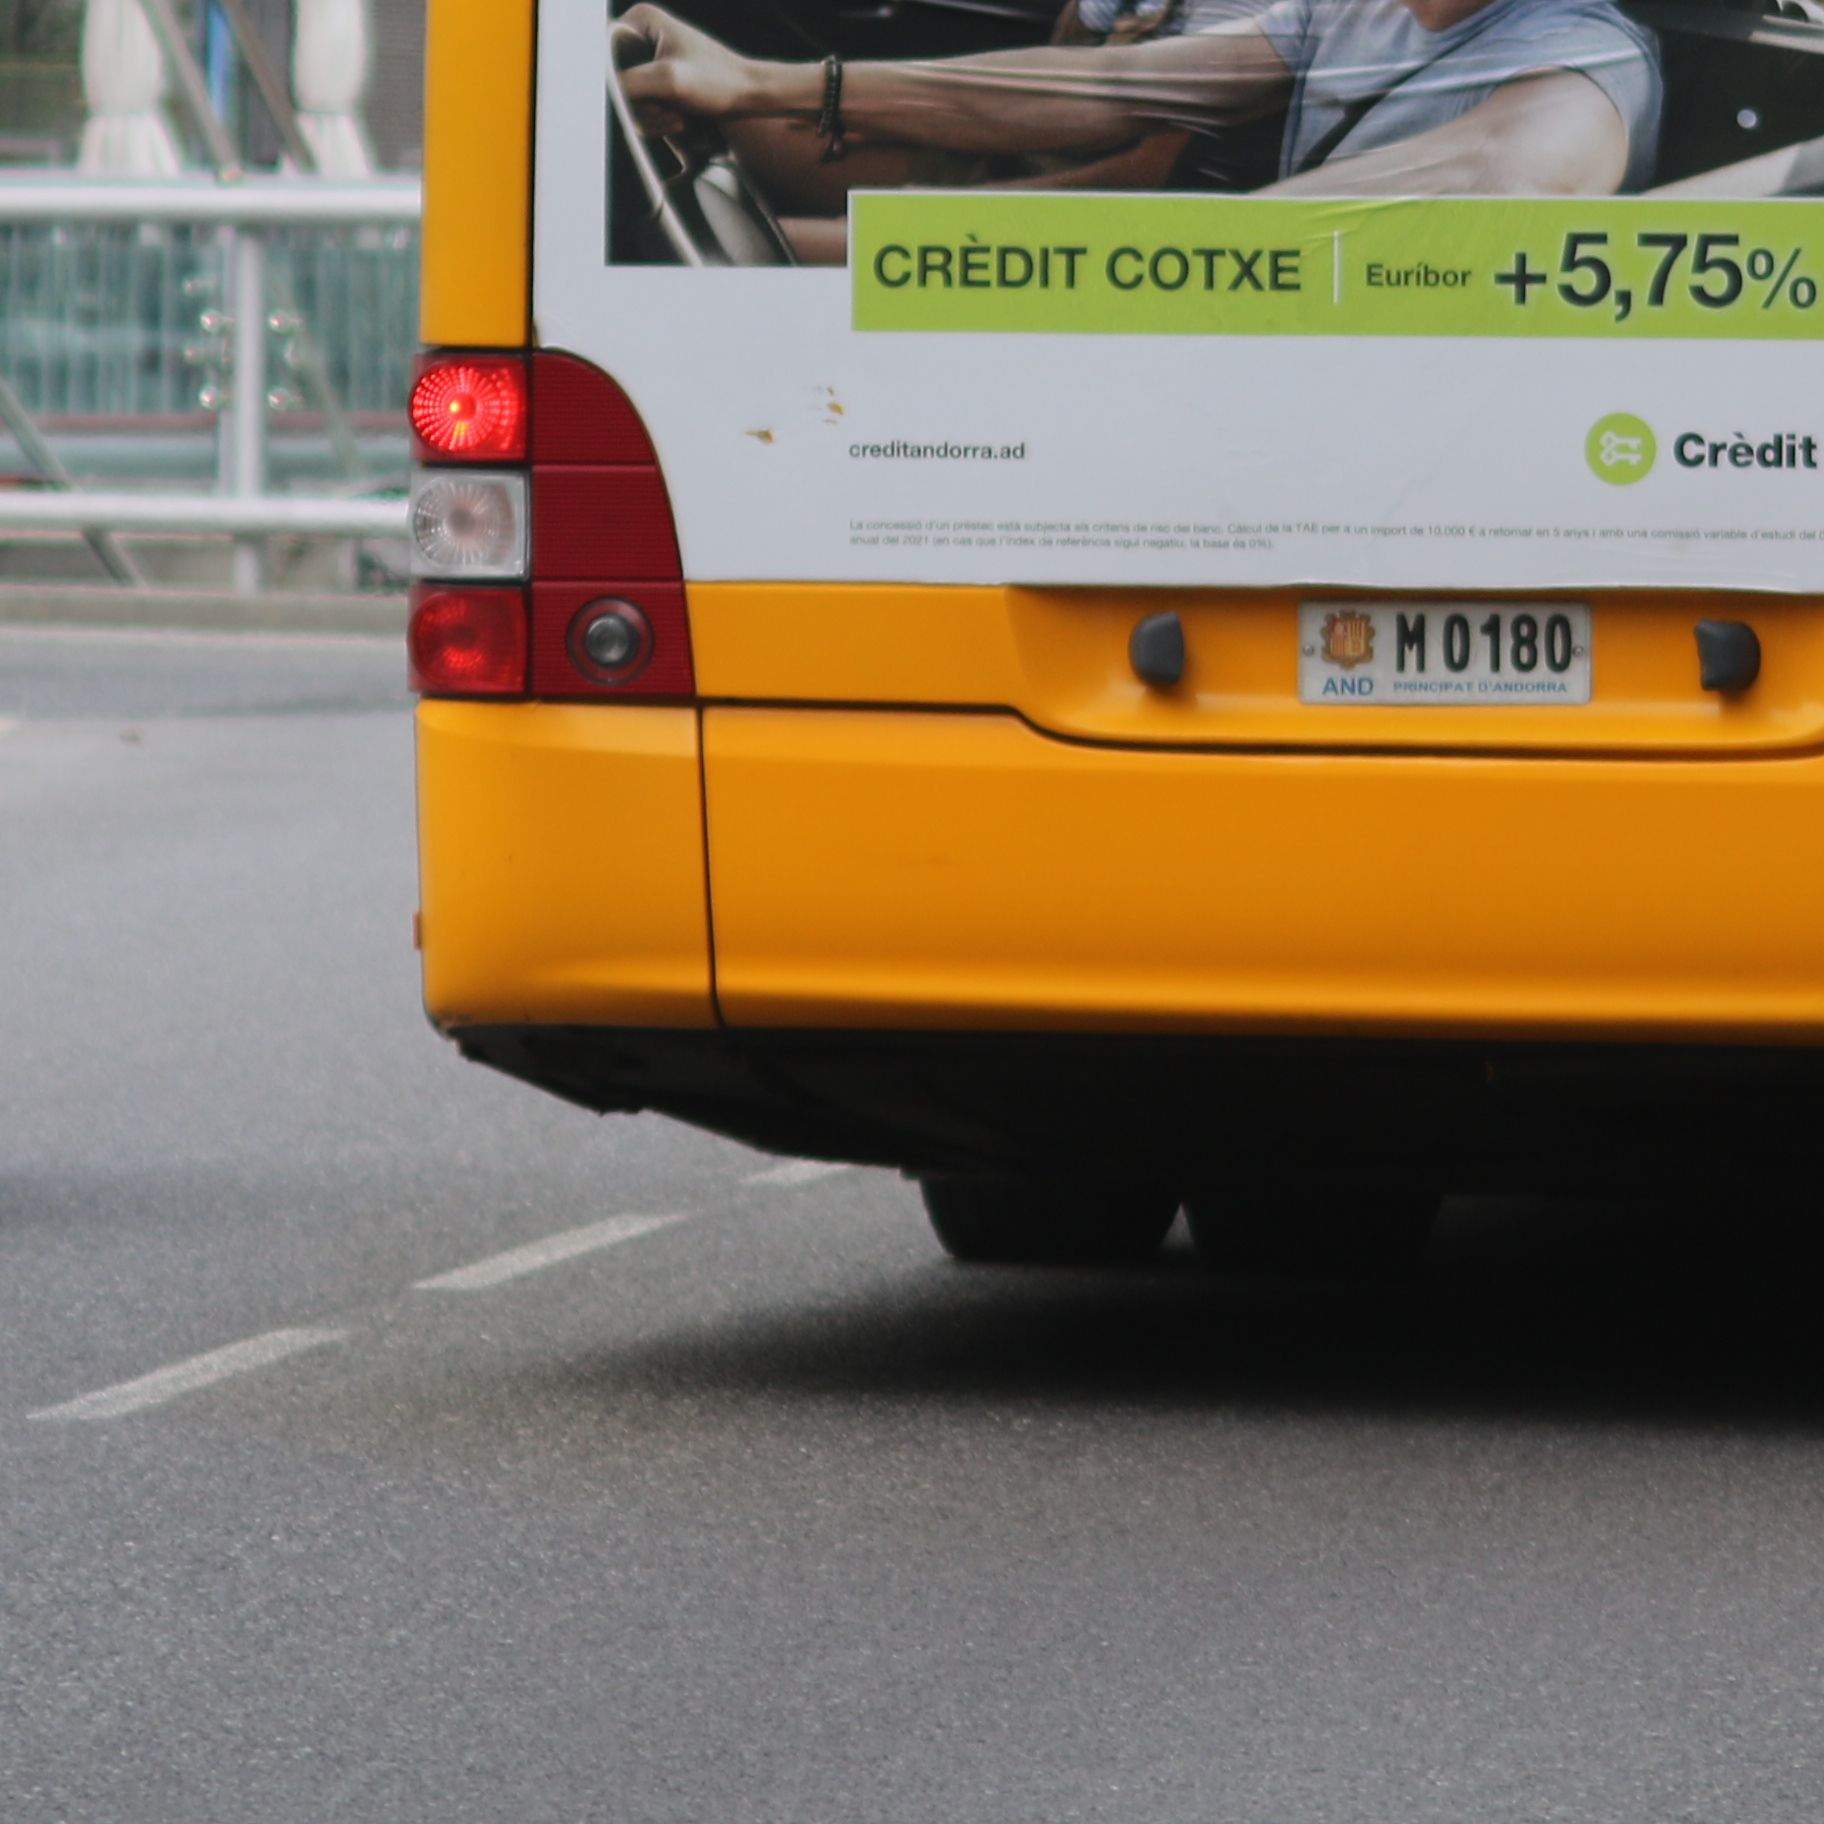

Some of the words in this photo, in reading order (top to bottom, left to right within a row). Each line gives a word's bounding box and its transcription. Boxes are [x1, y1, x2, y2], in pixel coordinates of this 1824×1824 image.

[873, 232, 1087, 290] CRÈDIT
[1105, 245, 1303, 293] COTXE
[1364, 262, 1472, 289] Euríbor
[1493, 231, 1818, 323] +5,75%
[848, 440, 1026, 460] creditandorra.ad
[1673, 431, 1818, 469] Crèdit
[1322, 676, 1374, 696] AND
[1392, 681, 1474, 693] PRINCIPAT
[1478, 681, 1568, 694] D'ANDORRA
